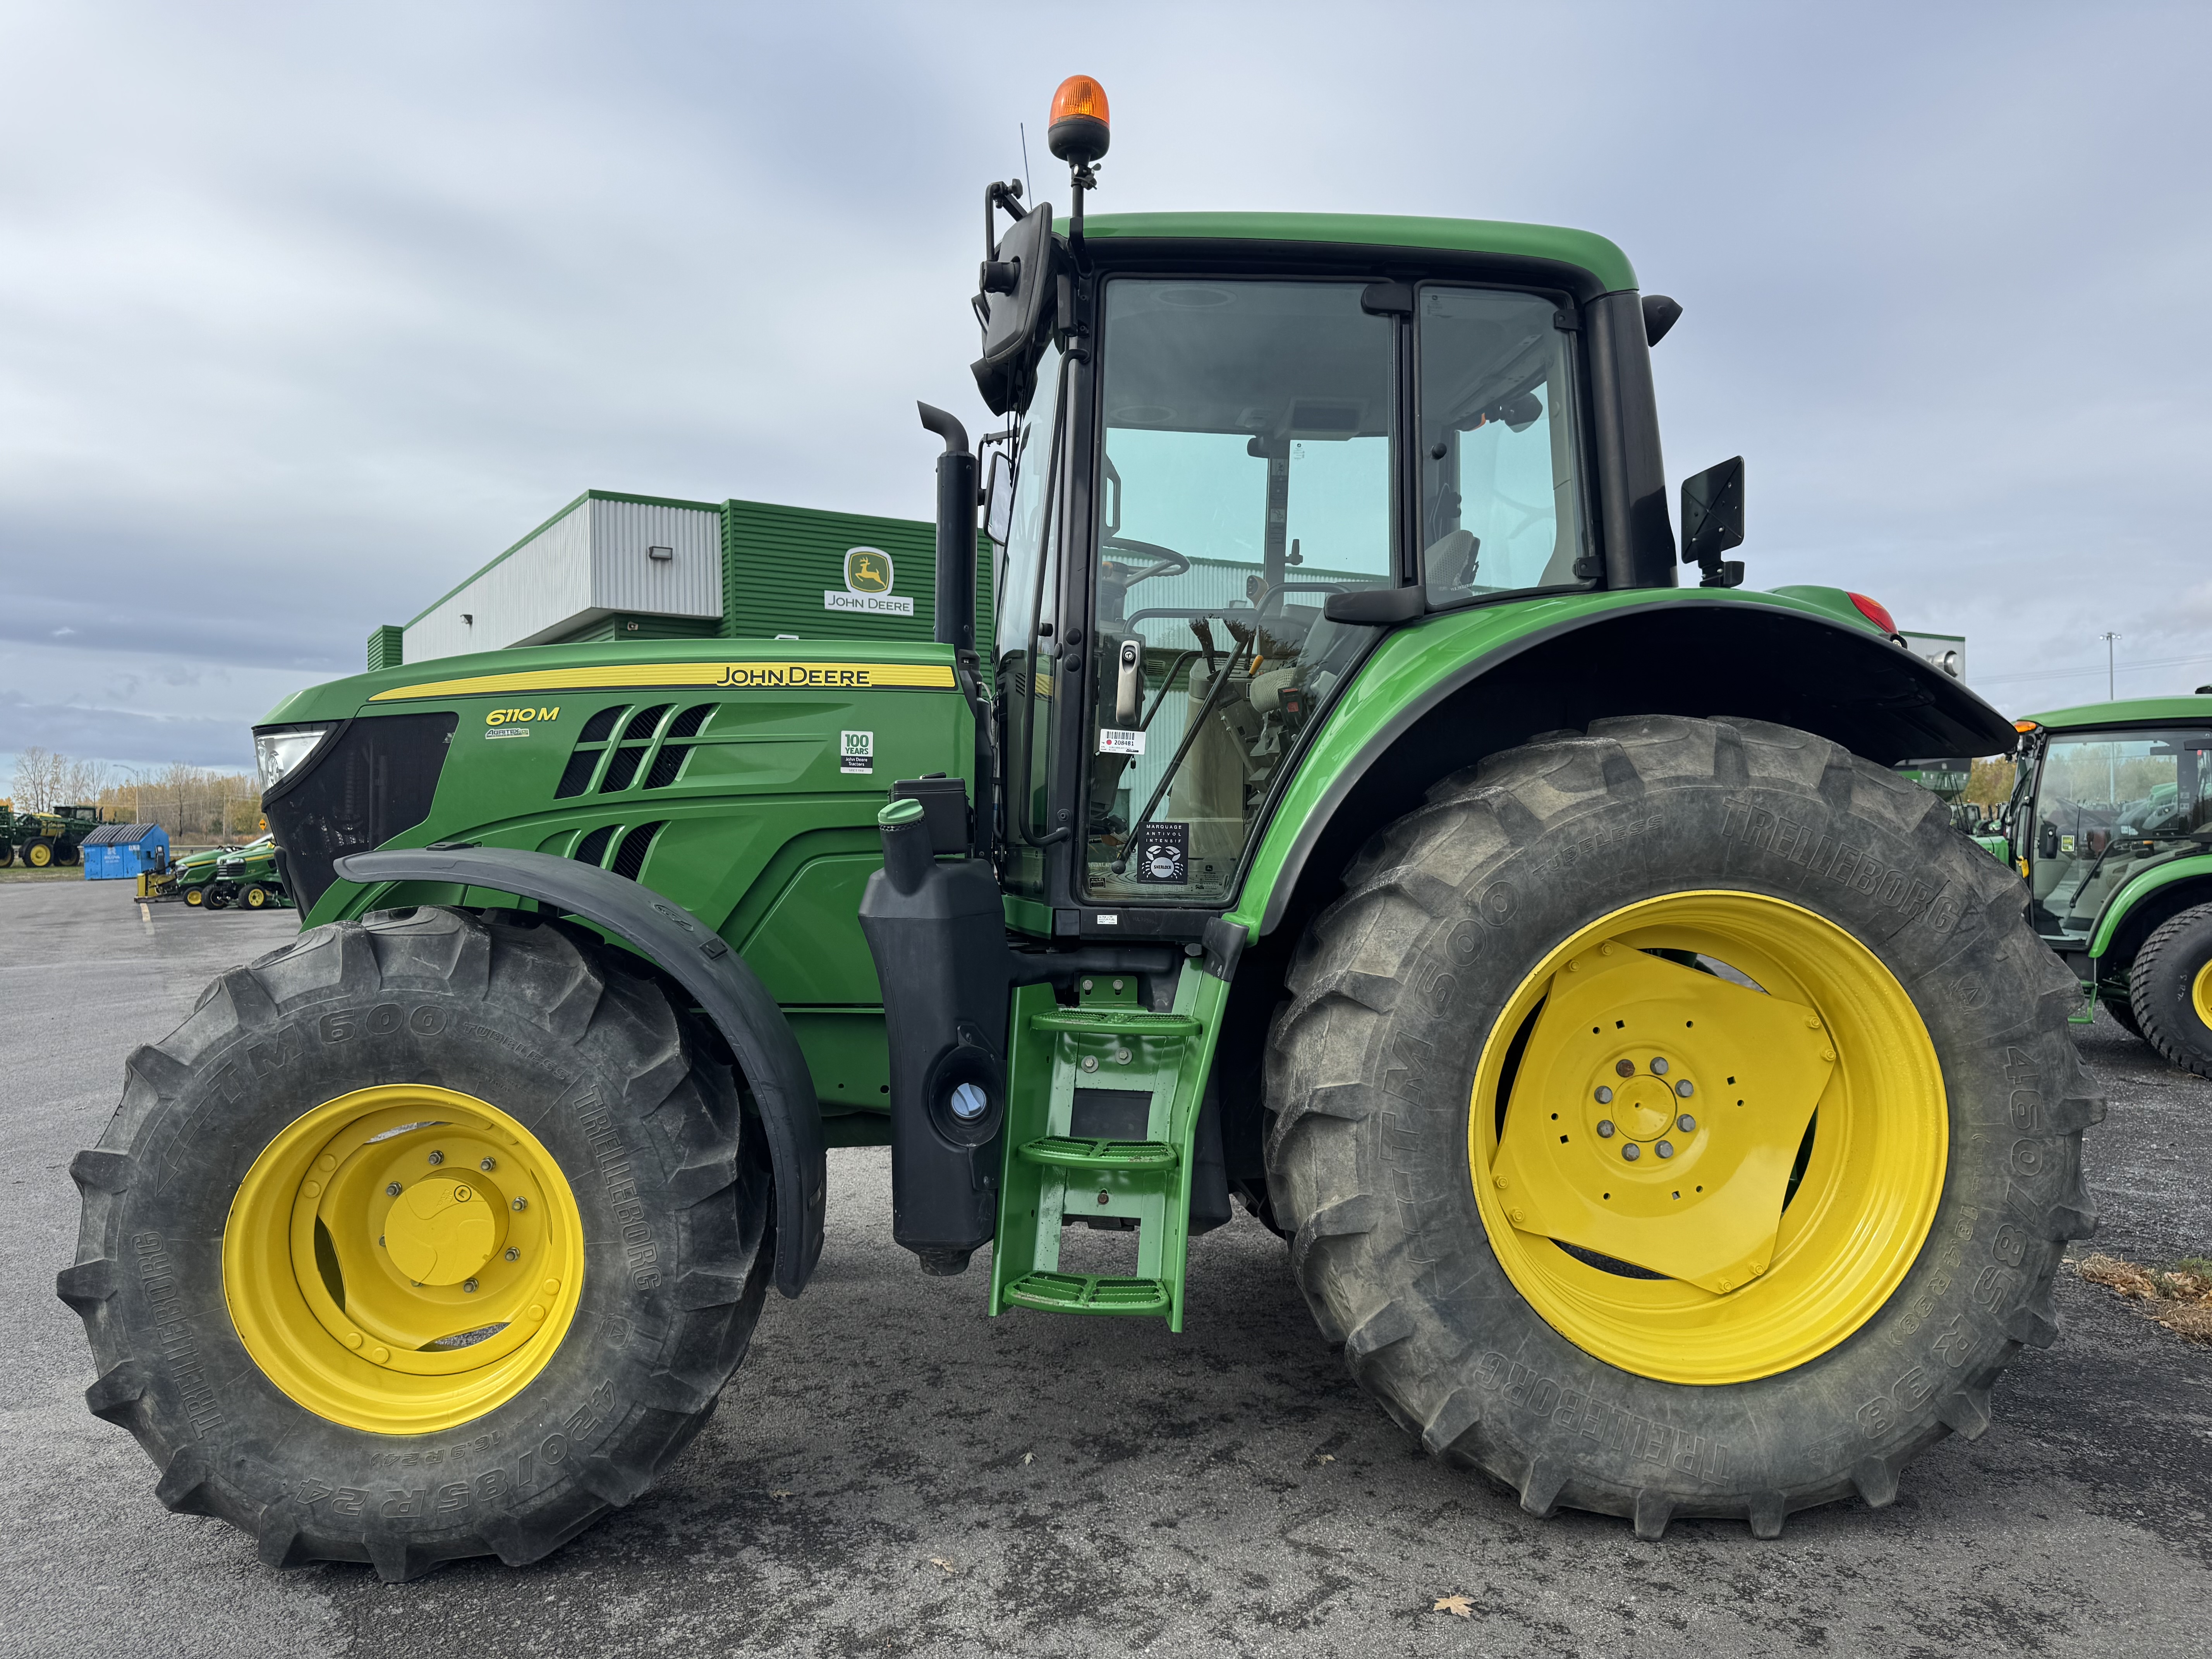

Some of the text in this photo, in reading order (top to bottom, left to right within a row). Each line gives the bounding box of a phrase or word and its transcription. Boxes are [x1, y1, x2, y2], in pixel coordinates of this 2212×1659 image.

[828, 595, 910, 612] JOHN DEERE
[716, 666, 870, 685] JOHN DEERE
[845, 734, 869, 748] 100
[1532, 814, 1663, 881] TUBELESS
[1721, 797, 1961, 934] TRELLEBORG
[1413, 879, 1520, 1018] 600
[319, 1003, 448, 1045] 600
[465, 1022, 570, 1080] TUBELESS
[573, 1084, 663, 1291] TRELLEBORG
[1857, 1046, 2044, 1440] 460/85 R 38
[131, 1231, 226, 1440] TRELLEBORG
[1473, 1351, 1730, 1486] TRELLEBORG
[295, 1477, 369, 1516] 24
[381, 1489, 426, 1518] R
